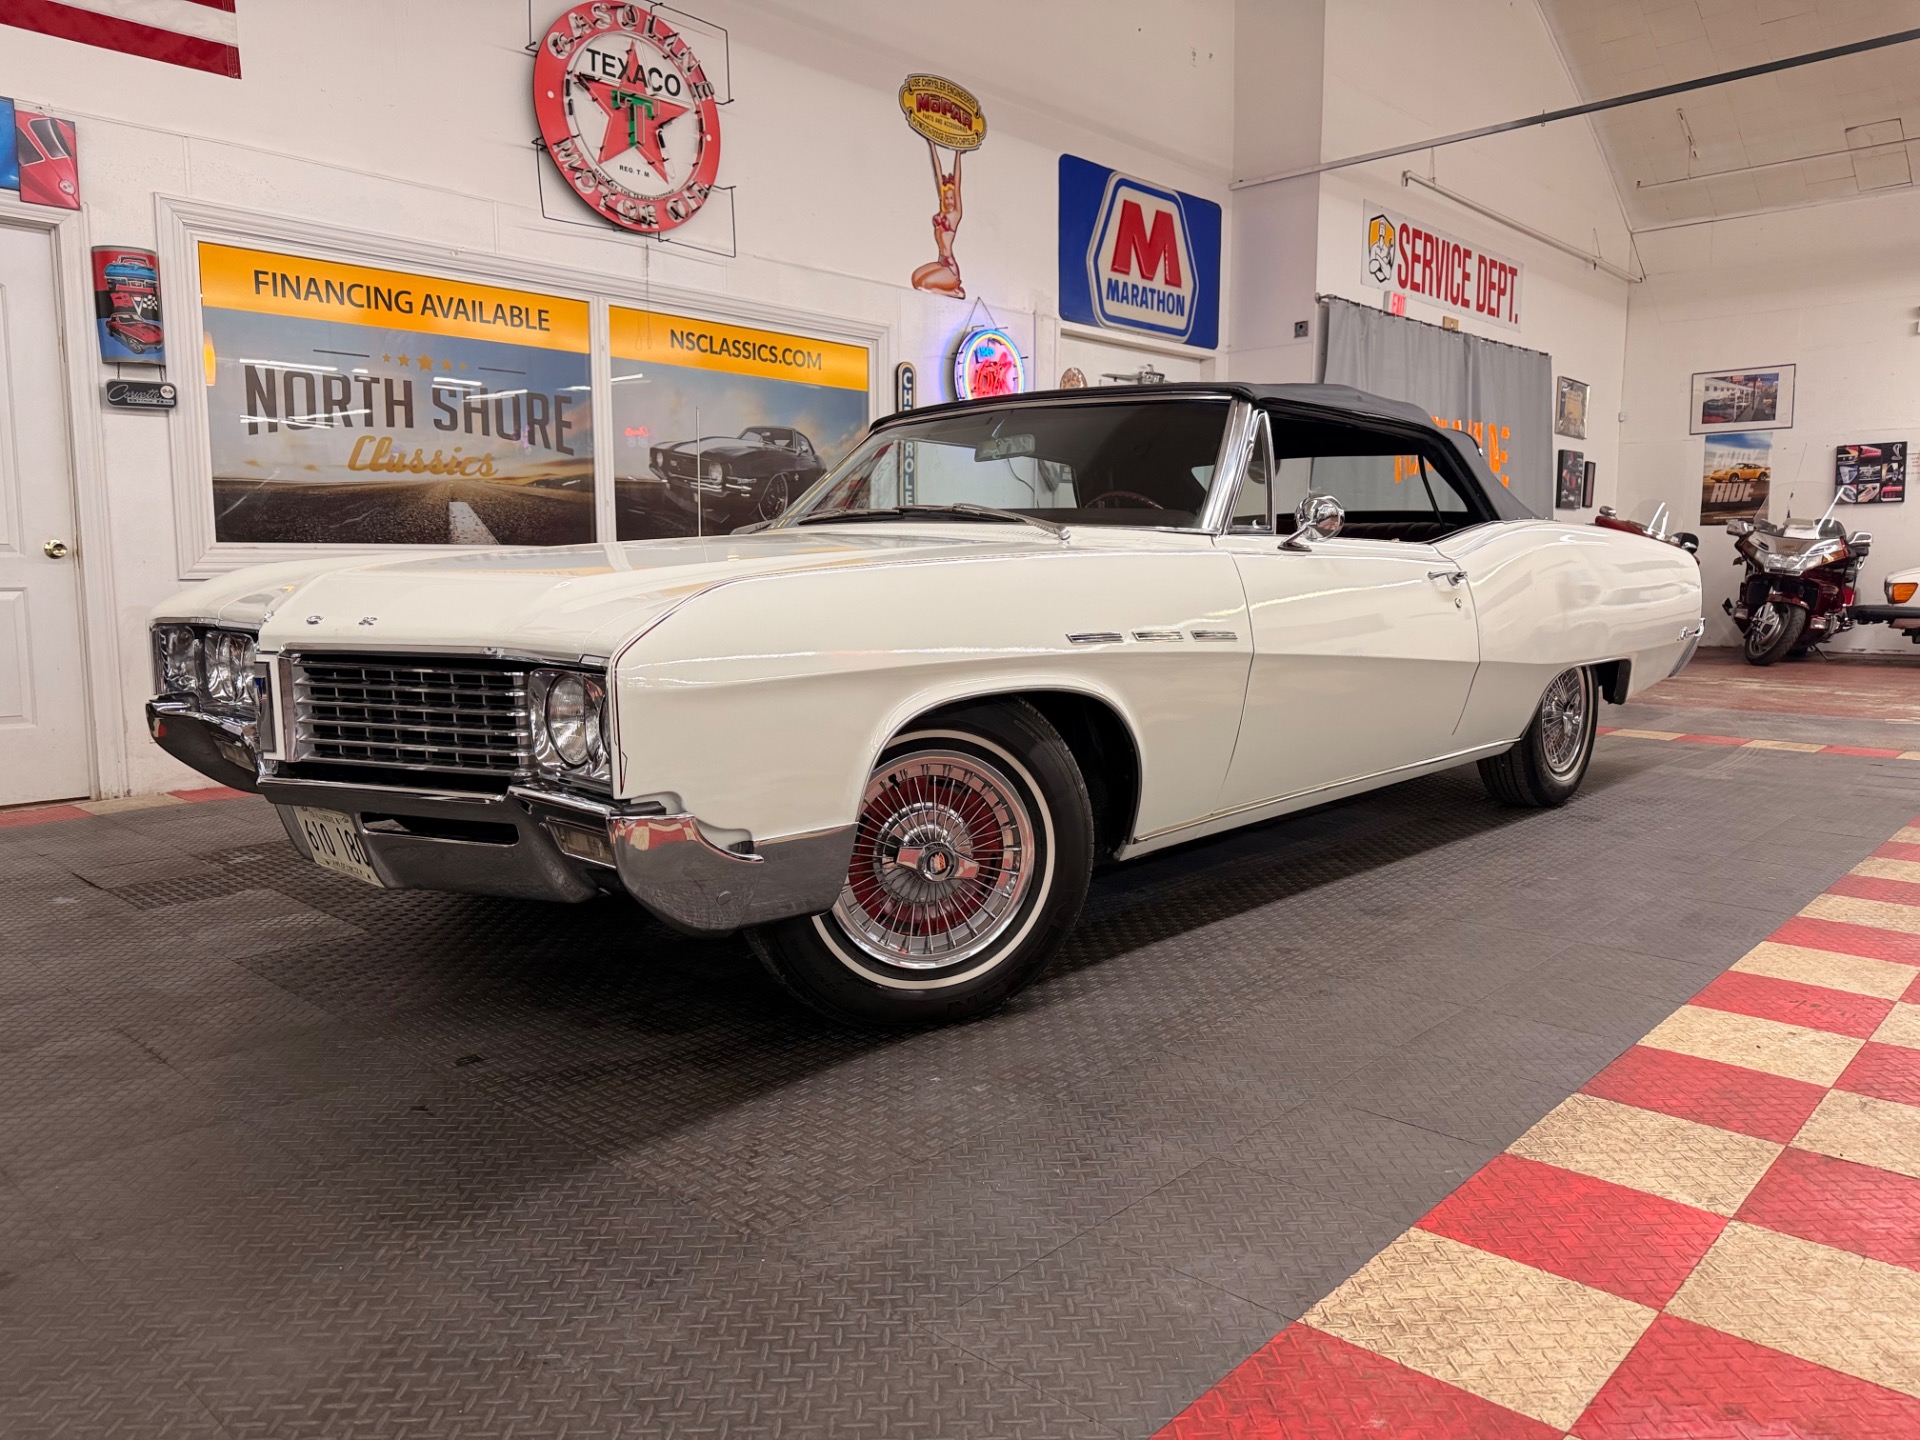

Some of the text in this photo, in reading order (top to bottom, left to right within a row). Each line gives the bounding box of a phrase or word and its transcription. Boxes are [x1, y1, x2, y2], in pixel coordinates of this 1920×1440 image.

[586, 48, 681, 97] TEXACO
[1110, 199, 1182, 289] M
[1397, 223, 1518, 324] SERVICE DEPT.
[253, 269, 551, 332] FINANCING AVAILABLE
[1106, 278, 1185, 317] MARATHON
[669, 329, 822, 371] NSCLASSICS.COM
[108, 384, 163, 402] Corvette
[244, 363, 575, 456] NORTH SHORE
[347, 435, 499, 478] Classics
[1710, 482, 1754, 503] RIDE
[304, 819, 336, 856] 610
